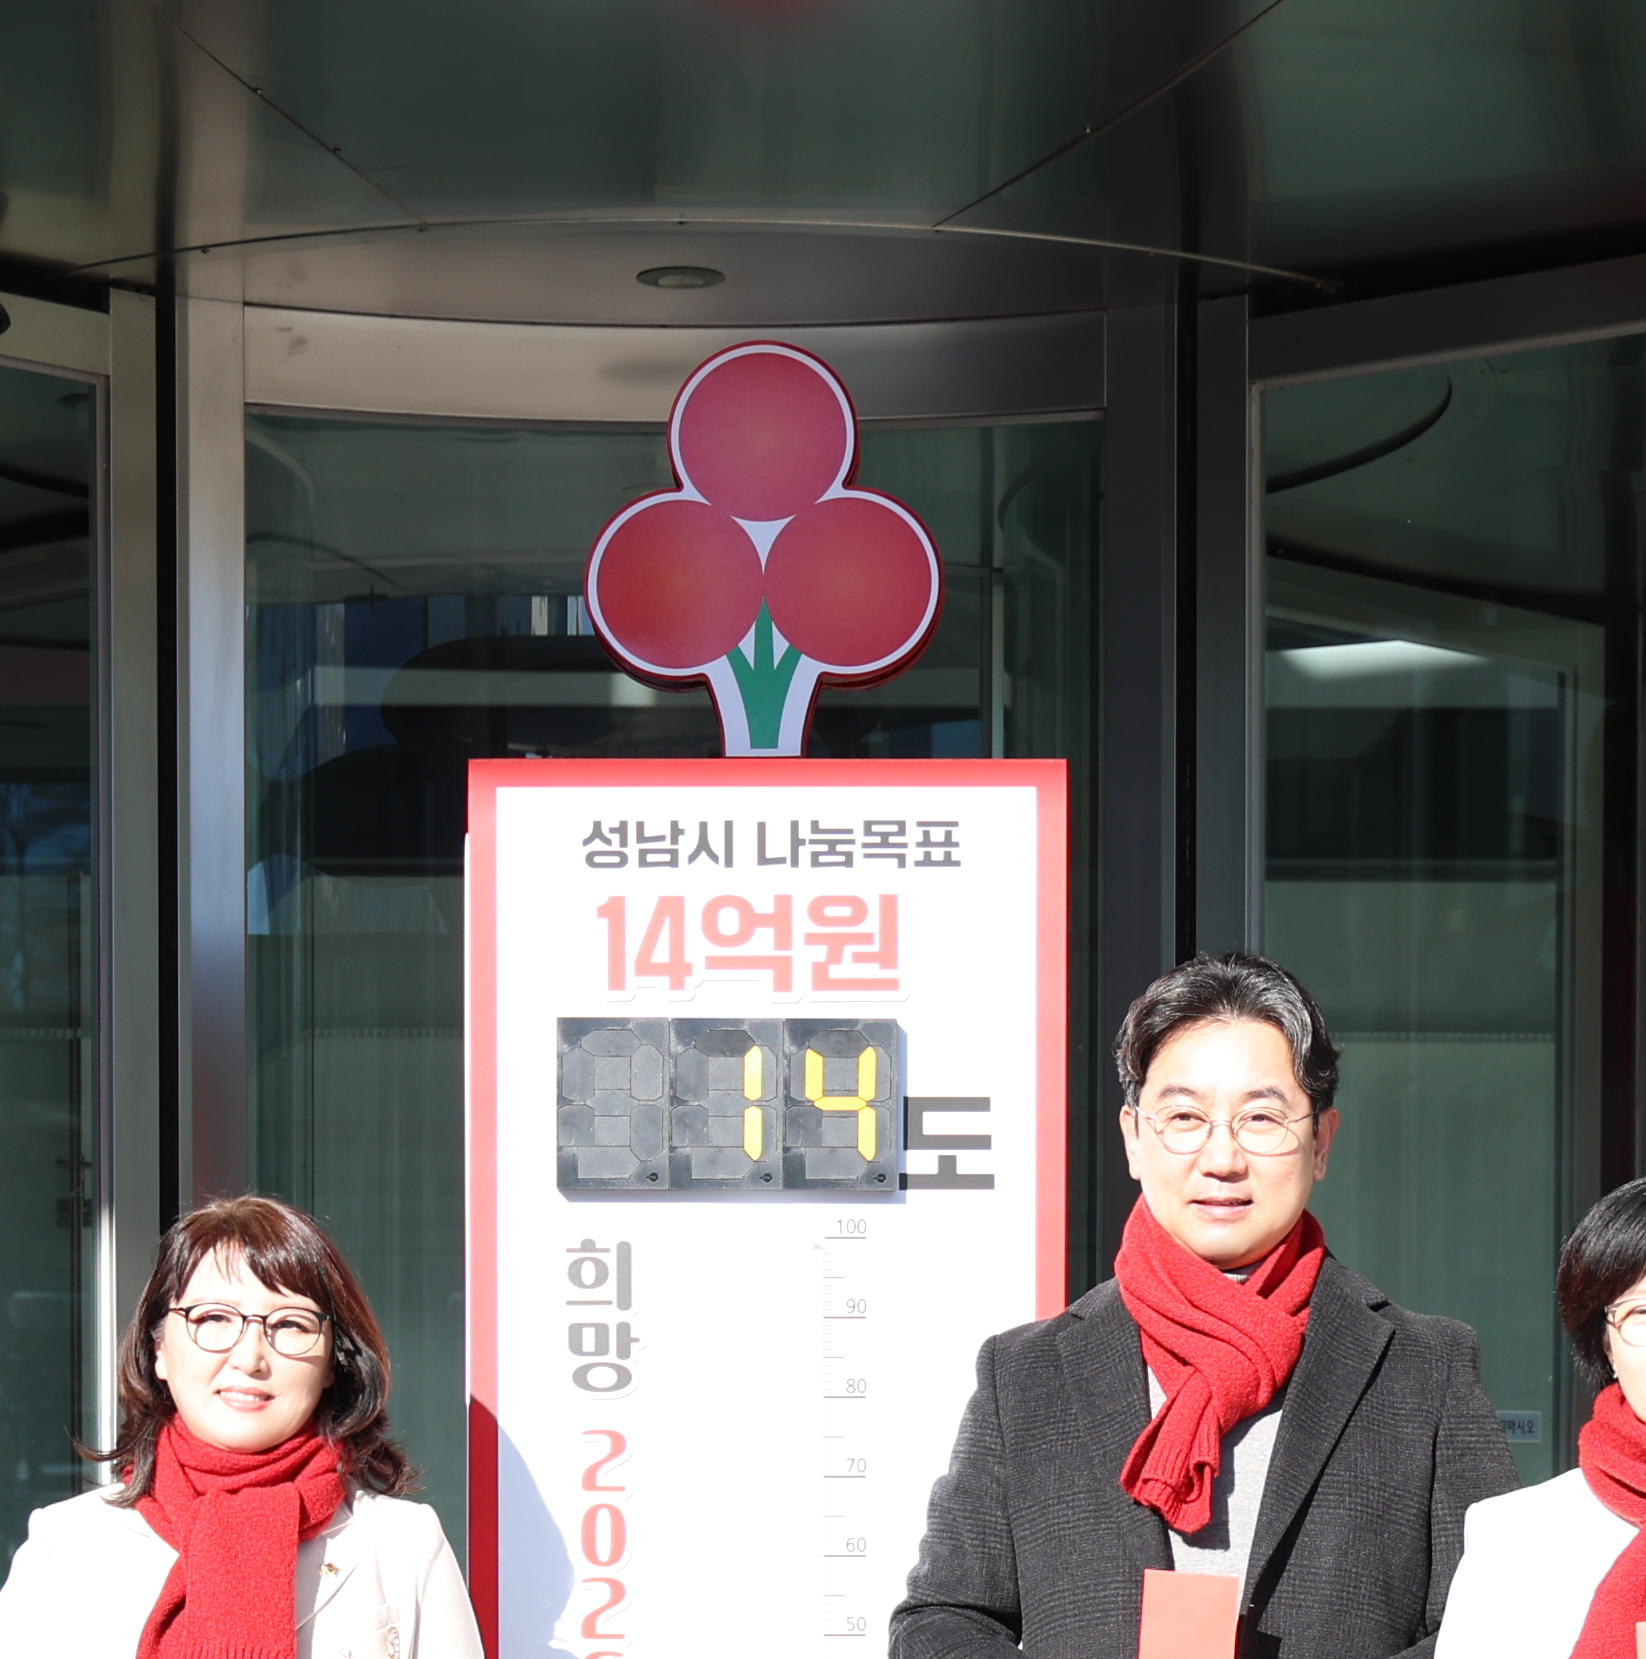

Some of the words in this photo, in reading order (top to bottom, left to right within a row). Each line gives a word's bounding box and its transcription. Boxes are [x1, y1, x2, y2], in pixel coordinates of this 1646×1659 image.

[582, 819, 734, 869] 성남시
[756, 819, 962, 869] 나눔목표
[596, 893, 900, 993] 14억원
[898, 1096, 995, 1191] 도
[837, 1219, 868, 1235] 100
[846, 1298, 867, 1314] 90
[565, 1238, 641, 1393] 희망
[846, 1378, 867, 1394] 80
[847, 1458, 867, 1473] 70
[846, 1537, 867, 1553] 60
[846, 1617, 867, 1632] 50
